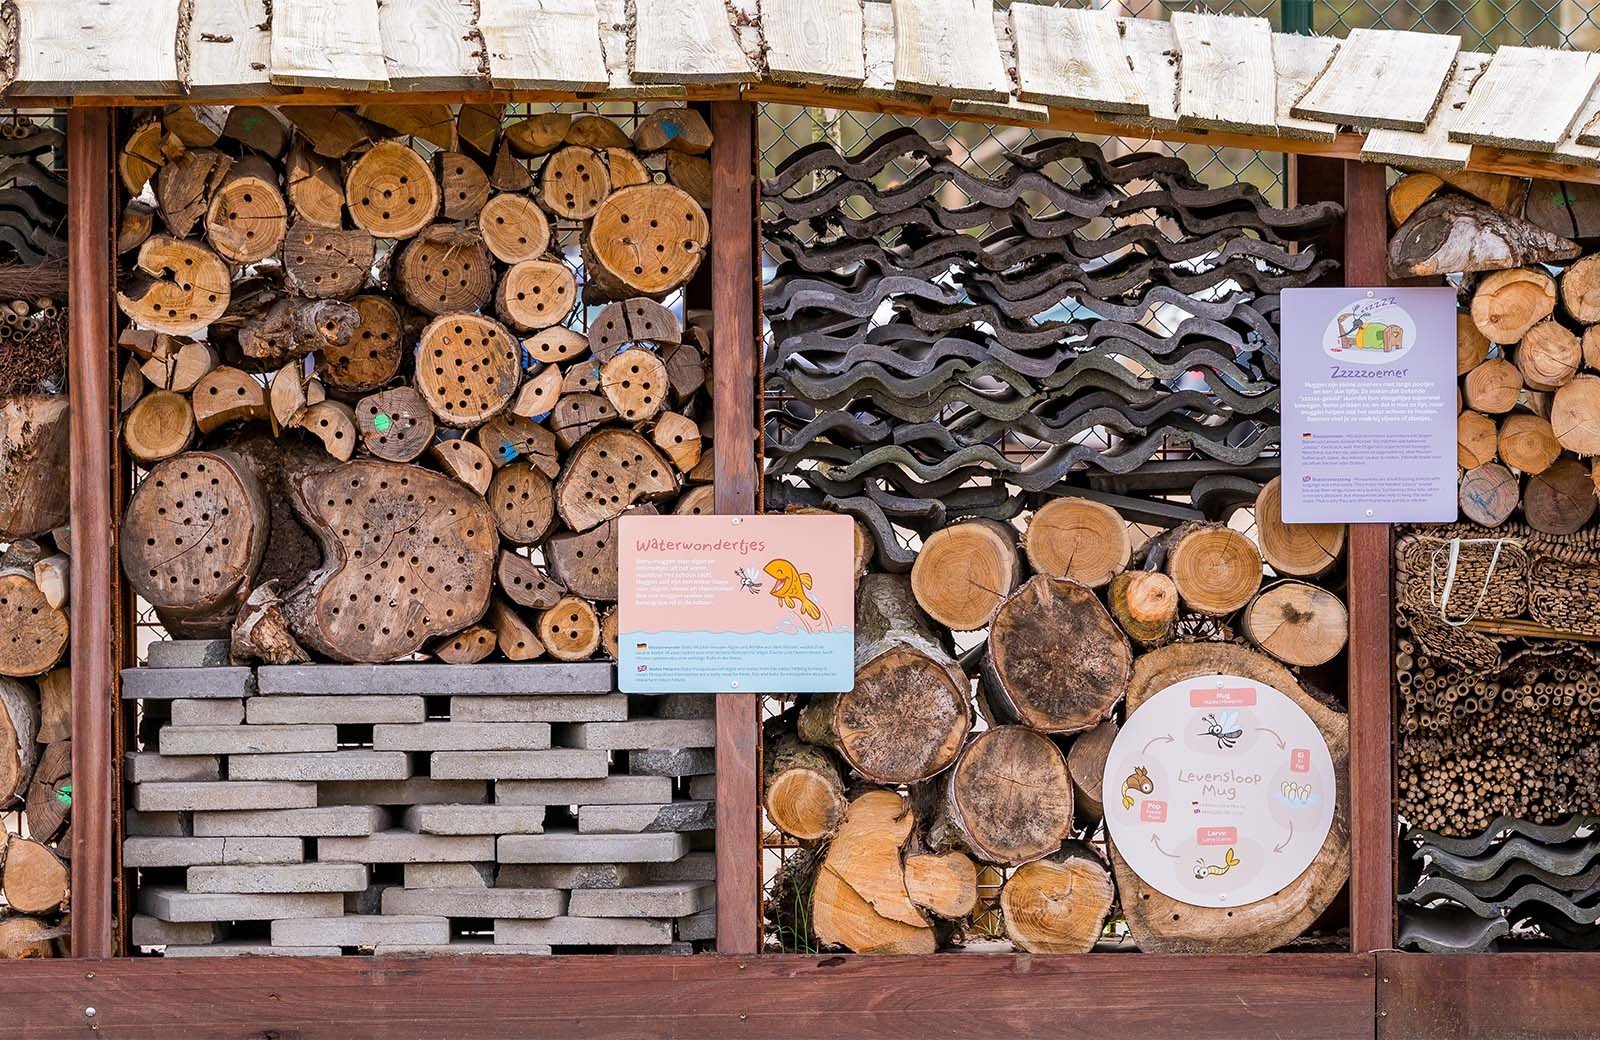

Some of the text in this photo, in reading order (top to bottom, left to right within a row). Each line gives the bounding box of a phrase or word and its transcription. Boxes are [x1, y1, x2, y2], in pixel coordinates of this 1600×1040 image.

[1330, 366, 1409, 379] Zzzzzoemer
[636, 538, 766, 556] Waterwondertjes
[1178, 768, 1262, 784] Levensloop
[1202, 784, 1237, 801] Mug
